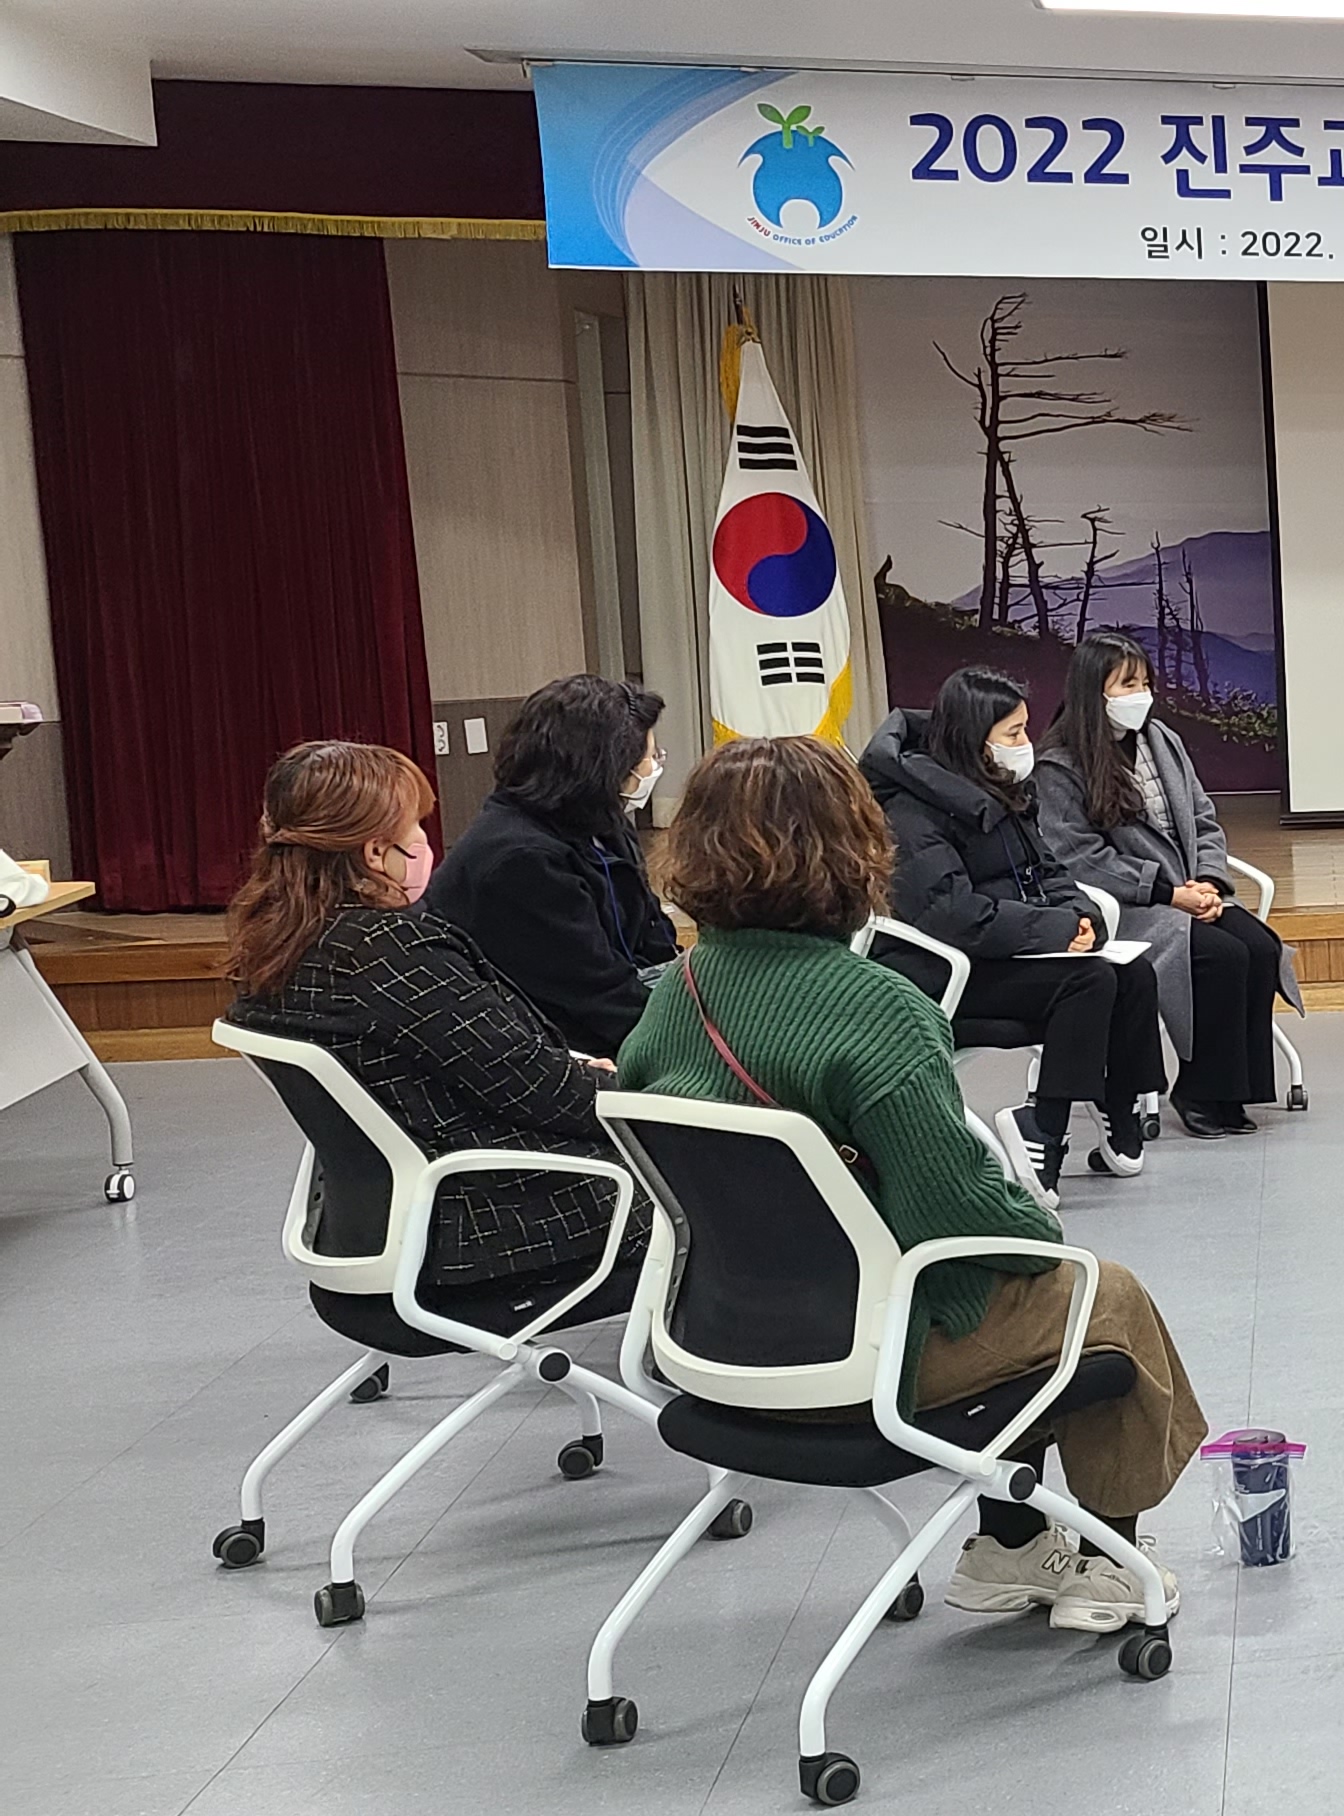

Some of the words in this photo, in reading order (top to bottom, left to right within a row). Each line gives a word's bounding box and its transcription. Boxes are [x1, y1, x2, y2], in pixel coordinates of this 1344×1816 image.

[910, 112, 1130, 185] 2022
[747, 216, 771, 237] JINJU
[772, 233, 802, 246] OFFICE
[804, 236, 816, 246] OF
[818, 214, 858, 243] EDUCATION
[1140, 226, 1203, 260] 일시
[1240, 230, 1334, 260] 2022.
